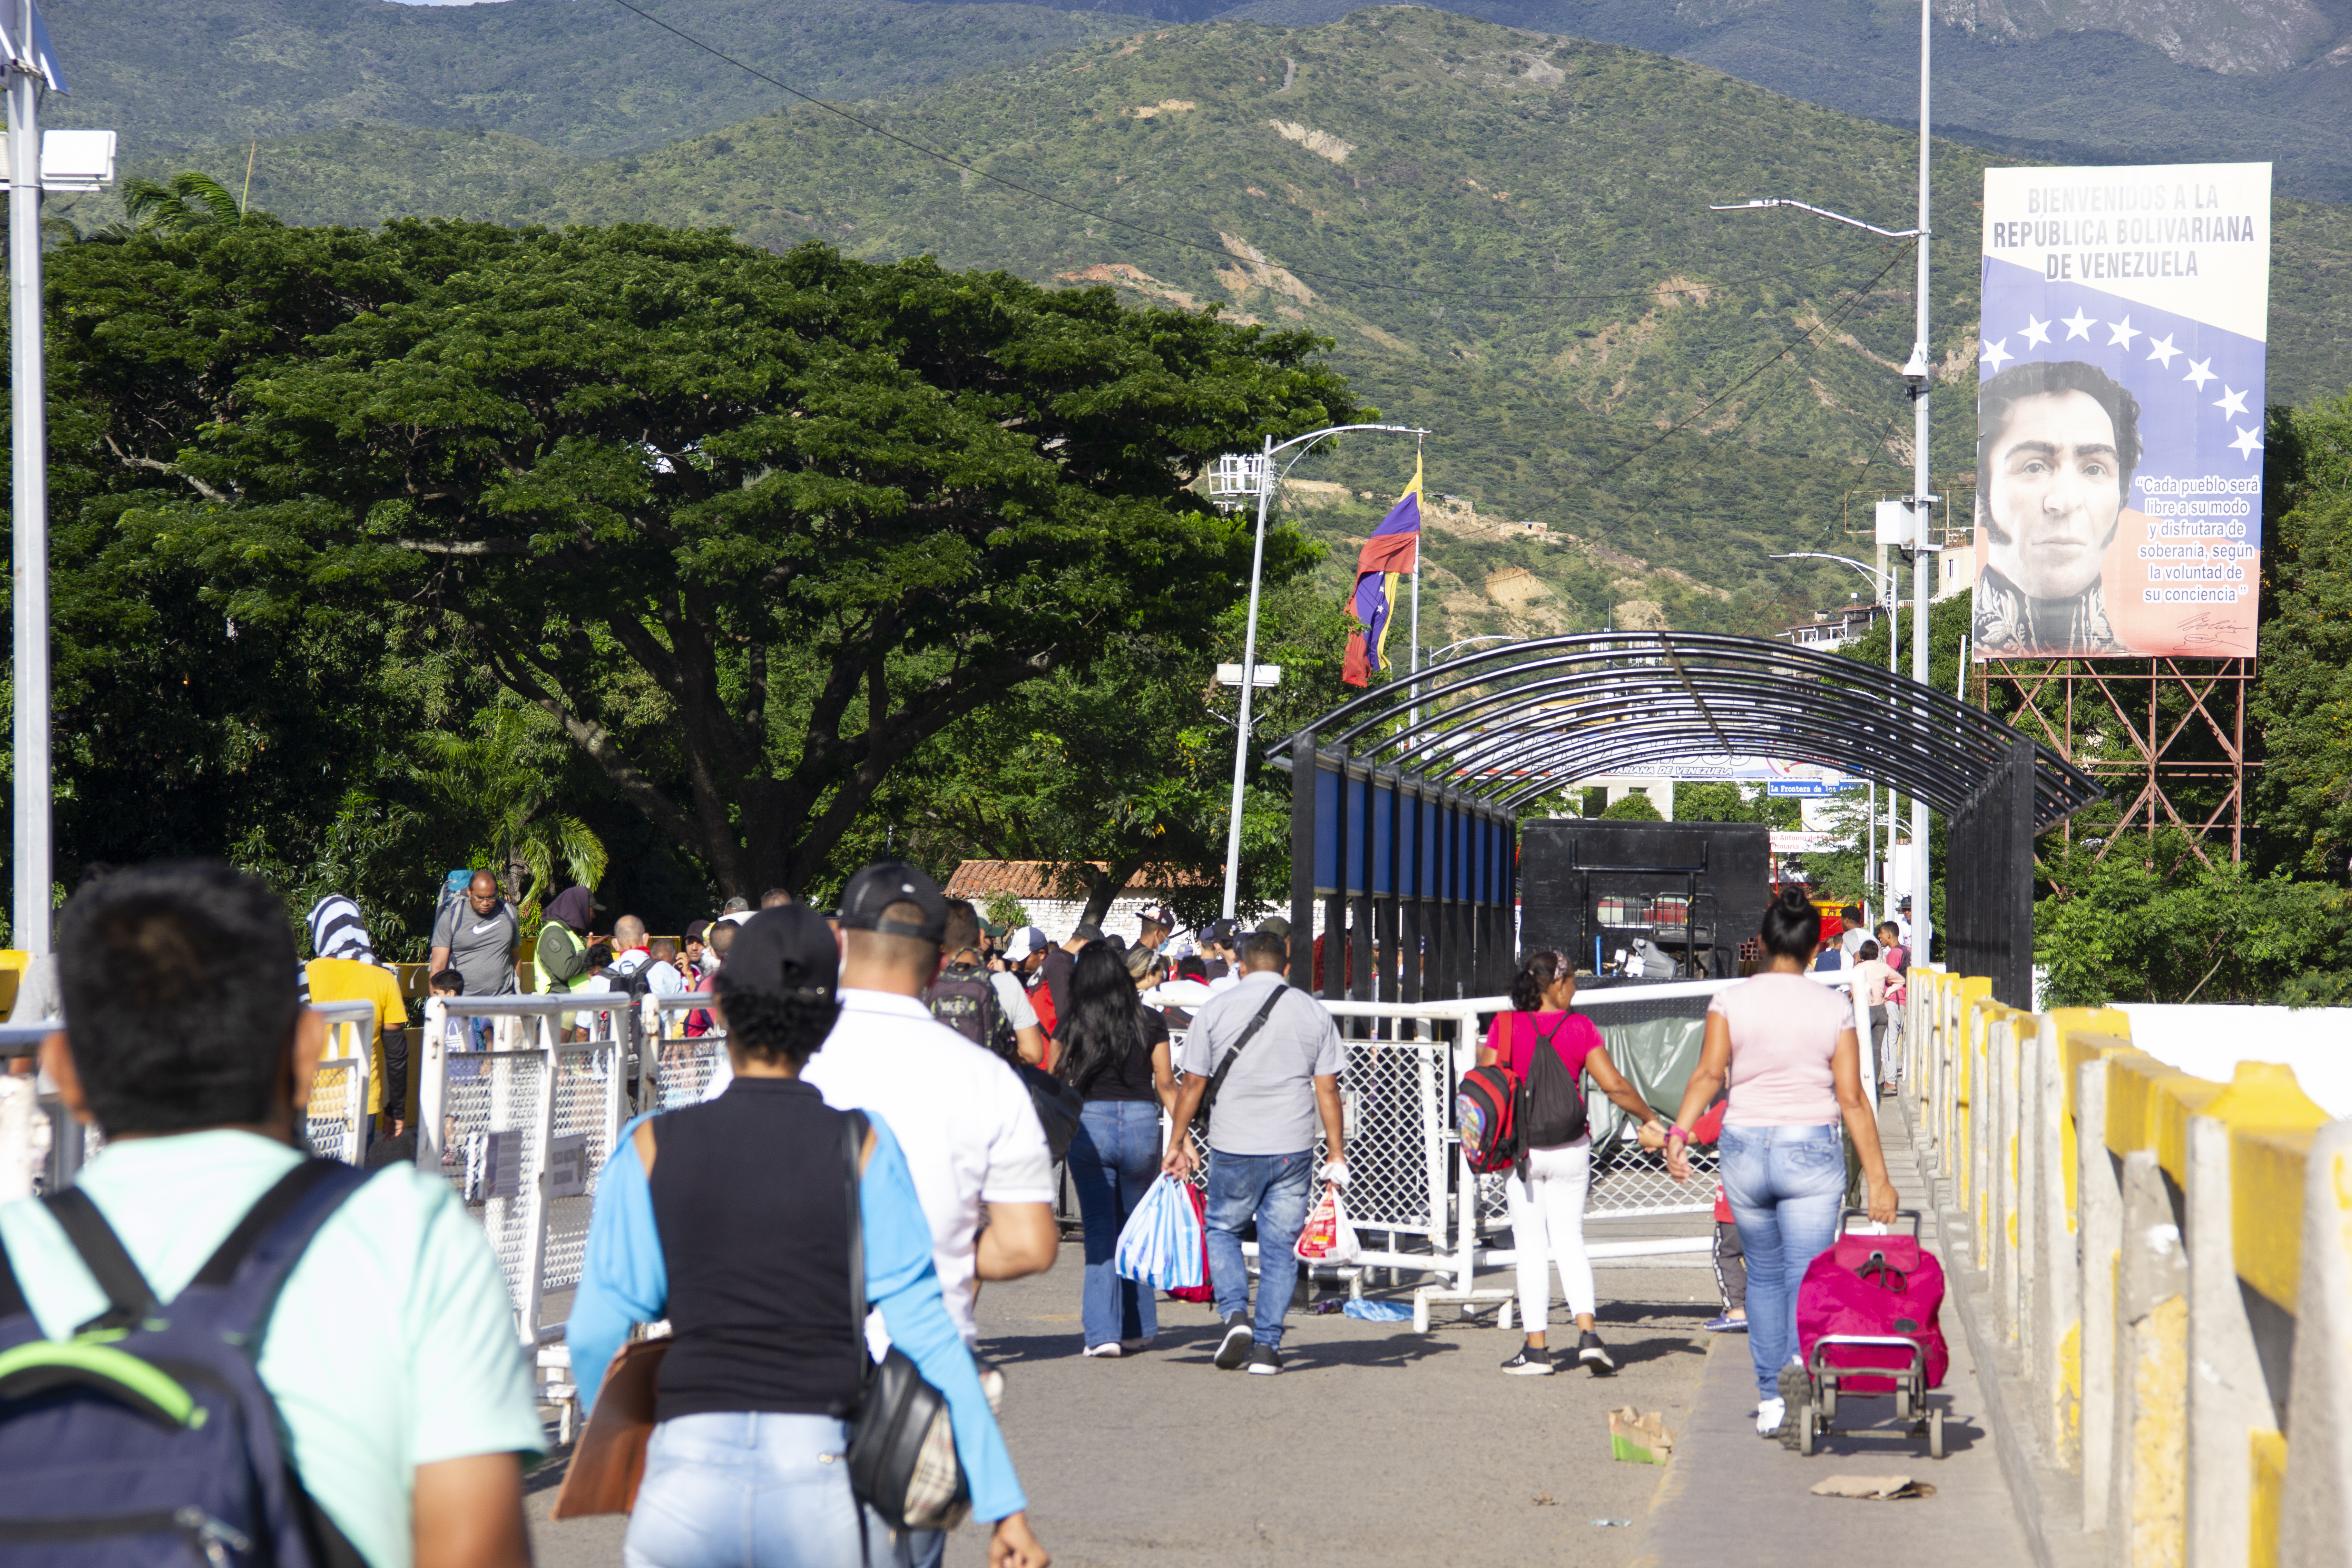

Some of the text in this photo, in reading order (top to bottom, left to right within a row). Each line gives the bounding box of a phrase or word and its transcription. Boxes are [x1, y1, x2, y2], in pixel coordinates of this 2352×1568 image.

[2029, 183, 2219, 213] BIENVENIDOS A LA
[1994, 215, 2254, 248] REPÚBLICA BOLIVARIANA
[2047, 250, 2198, 279] DE VENEZUELA
[2182, 477, 2225, 495] pueblo
[2230, 478, 2258, 492] será
[2146, 499, 2248, 514] libre a su modo
[2150, 521, 2244, 539] y disfrutara de
[2140, 543, 2253, 561] soberanía, según
[2151, 565, 2242, 579] la voluntad de
[2145, 590, 2160, 601] su
[1658, 766, 1673, 774] DE
[1676, 767, 1733, 776] VENEZUELA
